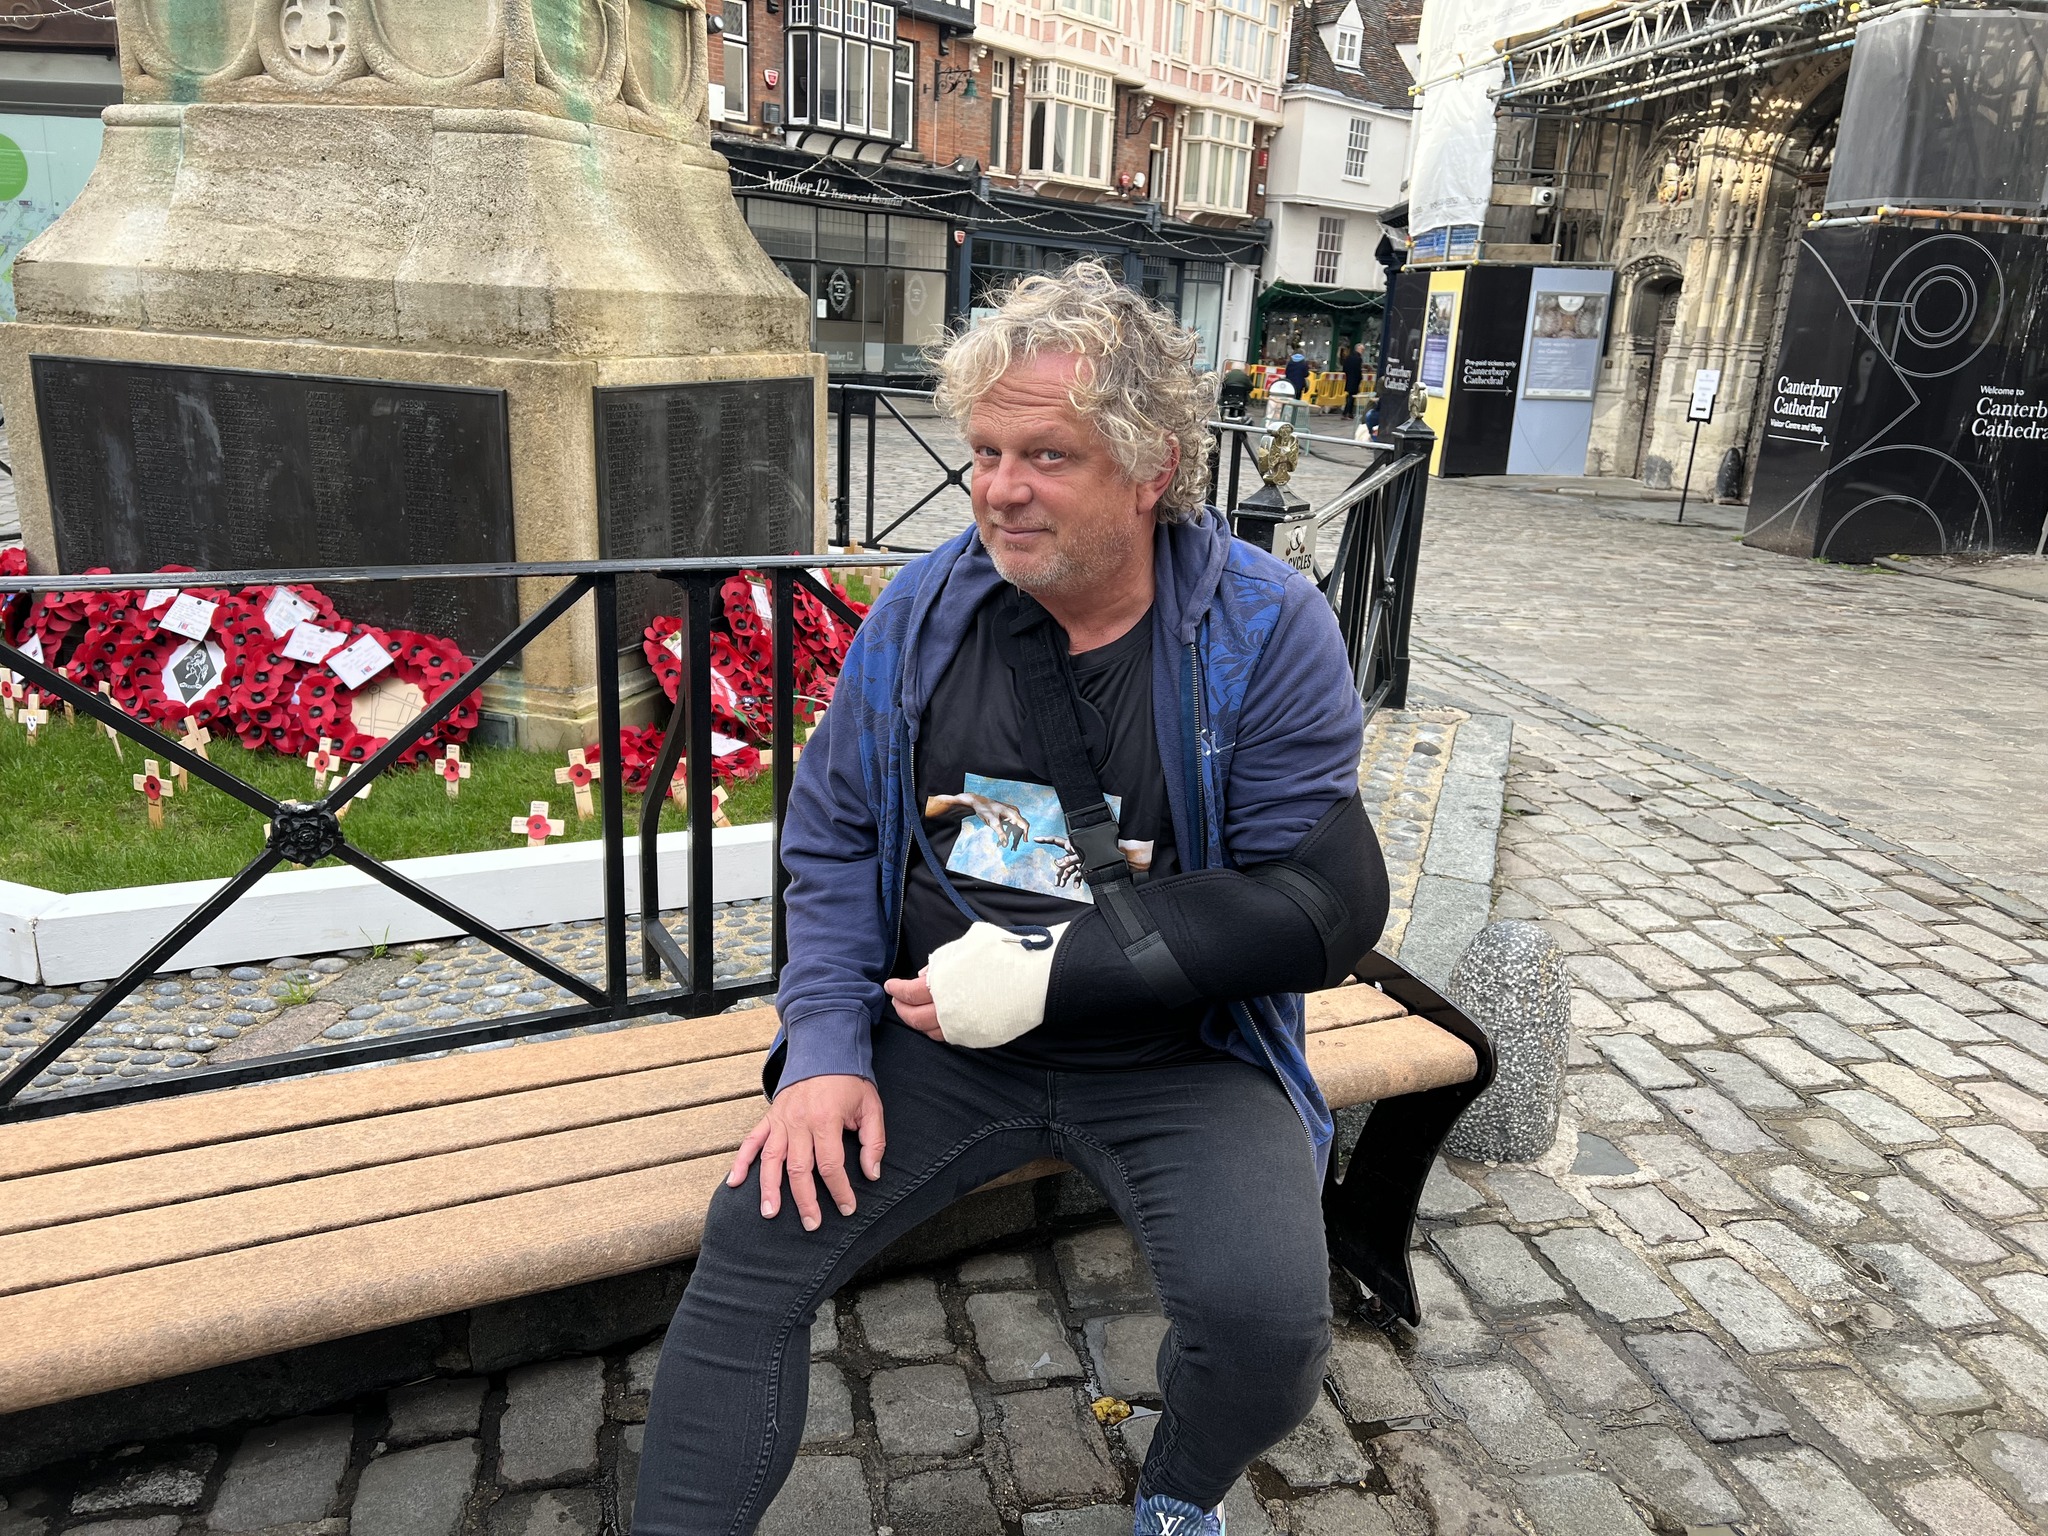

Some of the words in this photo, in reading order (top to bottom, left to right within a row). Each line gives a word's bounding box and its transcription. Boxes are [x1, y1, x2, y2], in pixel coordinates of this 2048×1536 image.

[764, 170, 813, 196] Number
[814, 178, 829, 197] 12
[1462, 374, 1504, 386] Cathedral
[1463, 365, 1512, 379] Canterbury
[1777, 375, 1843, 404] Canterbury
[1980, 385, 2015, 396] Welcome
[2015, 388, 2025, 396] to
[1773, 396, 1830, 419] Cathedral
